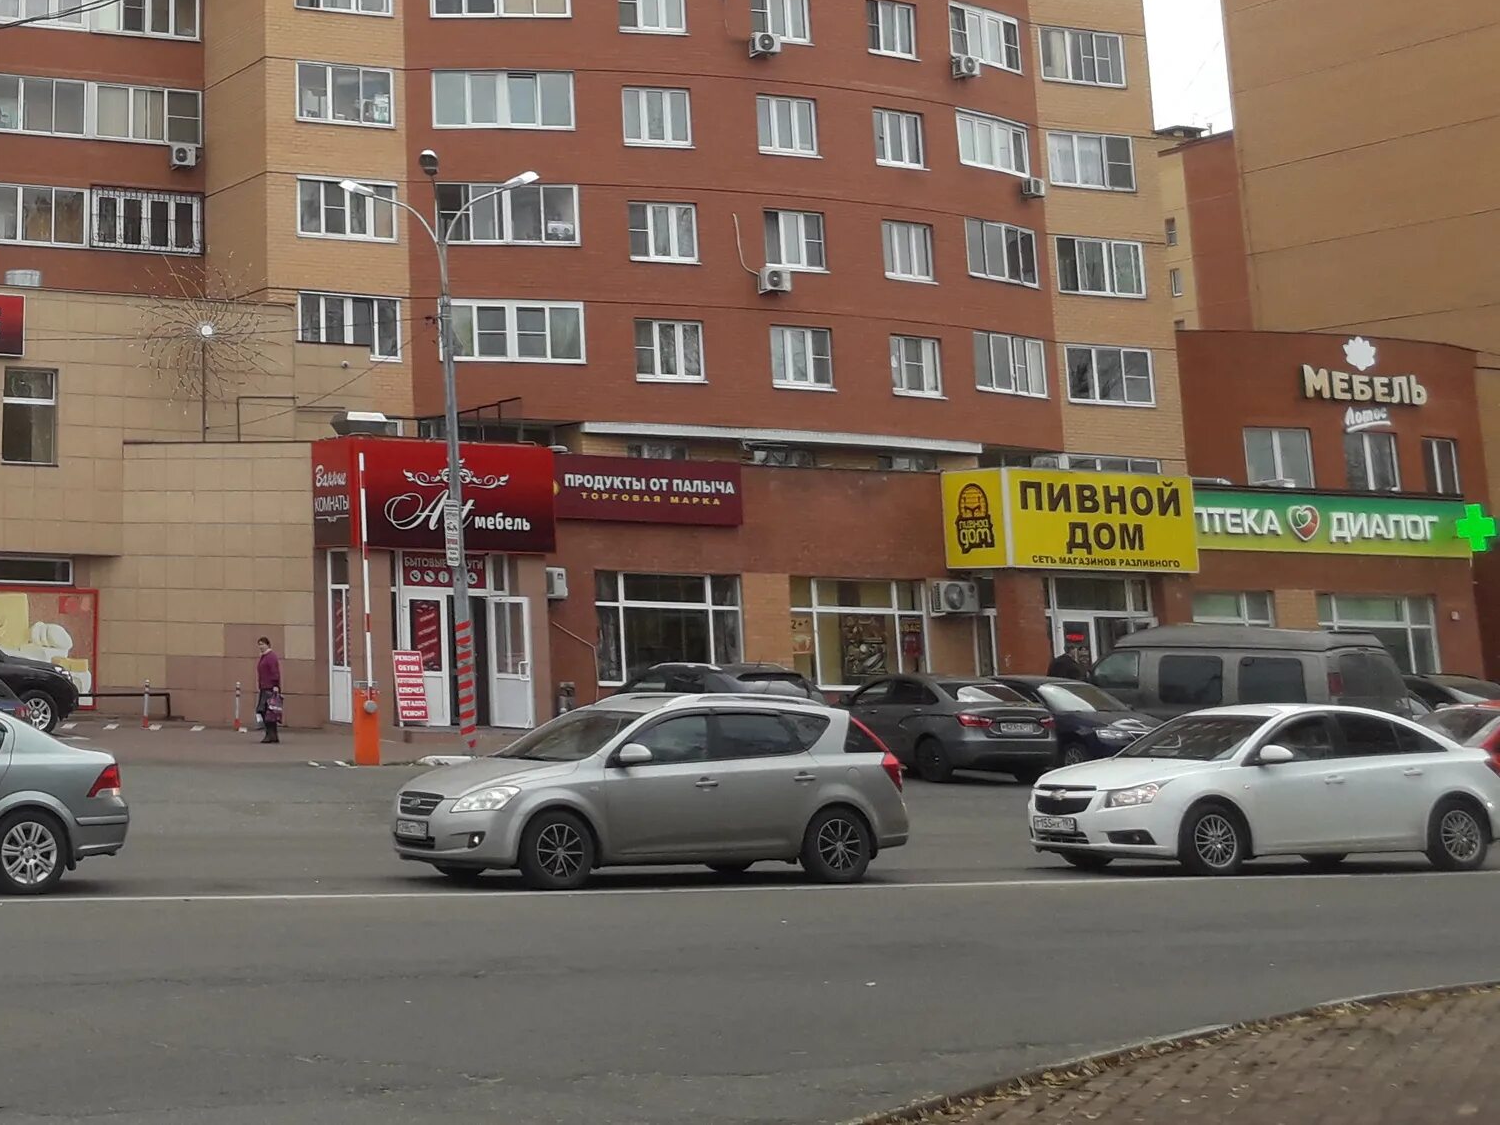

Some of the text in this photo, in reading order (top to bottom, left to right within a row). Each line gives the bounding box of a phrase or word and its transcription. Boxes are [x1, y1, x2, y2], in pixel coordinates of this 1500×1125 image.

[1302, 363, 1428, 406] МЕБЕЛЬ
[1345, 406, 1388, 426] Лотос
[564, 473, 735, 494] ПРОДУКТЫ ОТ ПАЛЫЧА
[315, 494, 350, 513] КОМНАТЫ
[581, 491, 721, 506] ТОРГОВАЯ МАРКА
[1019, 479, 1182, 517] ПИВНОЙ
[474, 512, 531, 532] мебель
[1193, 506, 1439, 544] ПТЕКА ДИАЛОГ
[1066, 521, 1145, 555] ДОМ
[404, 556, 447, 568] БЫТОВЫЕ
[1031, 554, 1181, 568] СЕТЬ МАГАЗИНОВ РАЗЛИВНОГО
[394, 654, 420, 662] РЕМОНТ
